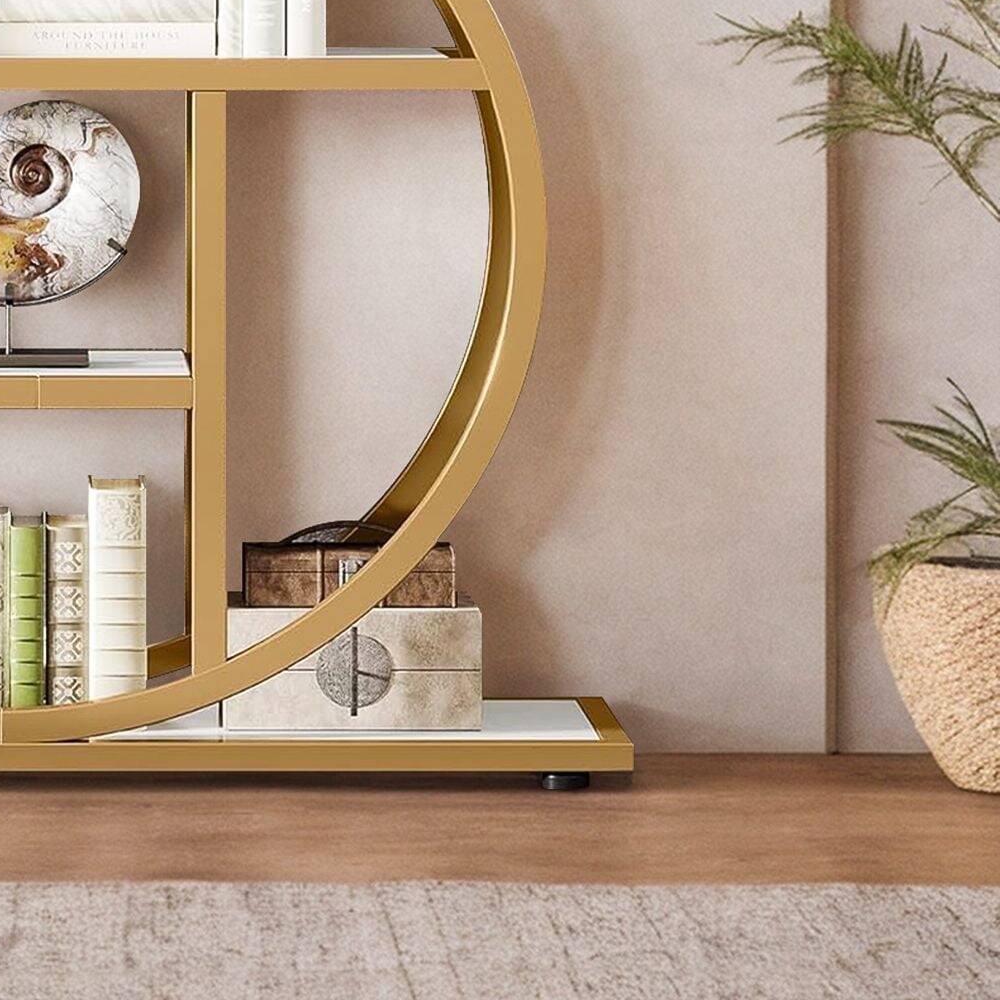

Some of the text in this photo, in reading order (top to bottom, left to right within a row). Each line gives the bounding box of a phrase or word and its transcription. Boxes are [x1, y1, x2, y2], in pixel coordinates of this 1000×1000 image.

[32, 31, 181, 40] AROUND THE HOUSE
[65, 41, 147, 50] FURNITURE
